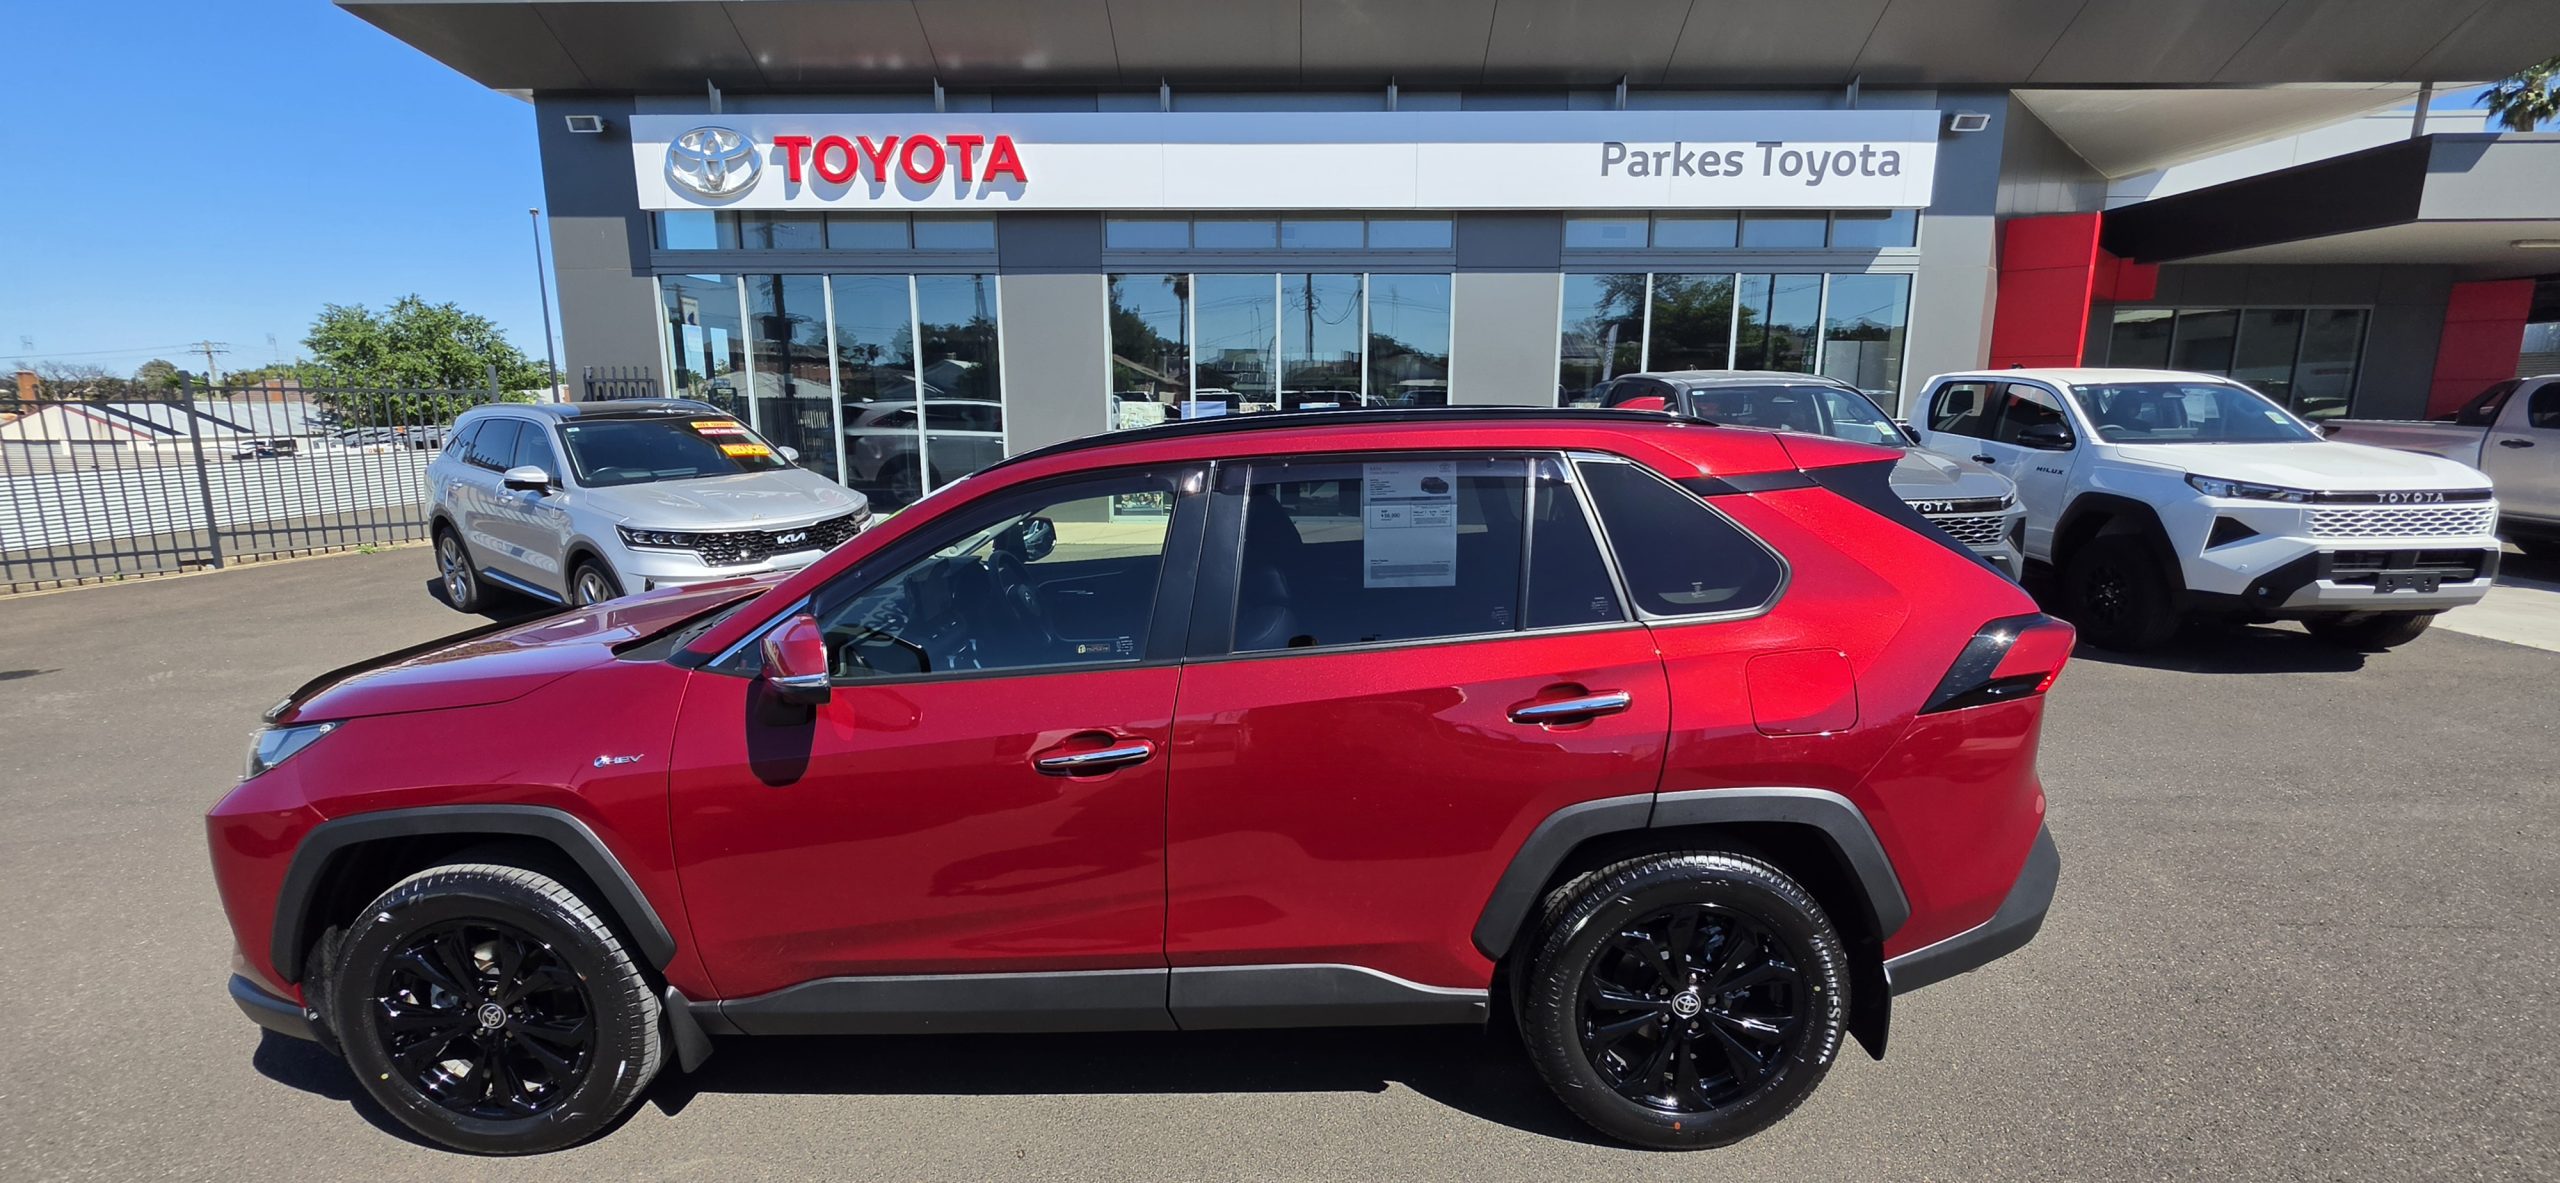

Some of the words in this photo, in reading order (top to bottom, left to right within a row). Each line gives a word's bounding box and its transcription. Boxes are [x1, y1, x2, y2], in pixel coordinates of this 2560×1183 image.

[773, 134, 1028, 184] TOYOTA
[1600, 141, 1744, 177] Parkes
[1756, 141, 1901, 187] Toyota
[2036, 466, 2064, 475] HILUX
[2377, 492, 2445, 503] TOYOTA
[1911, 500, 1954, 511] YOTA
[776, 532, 806, 544] KIA
